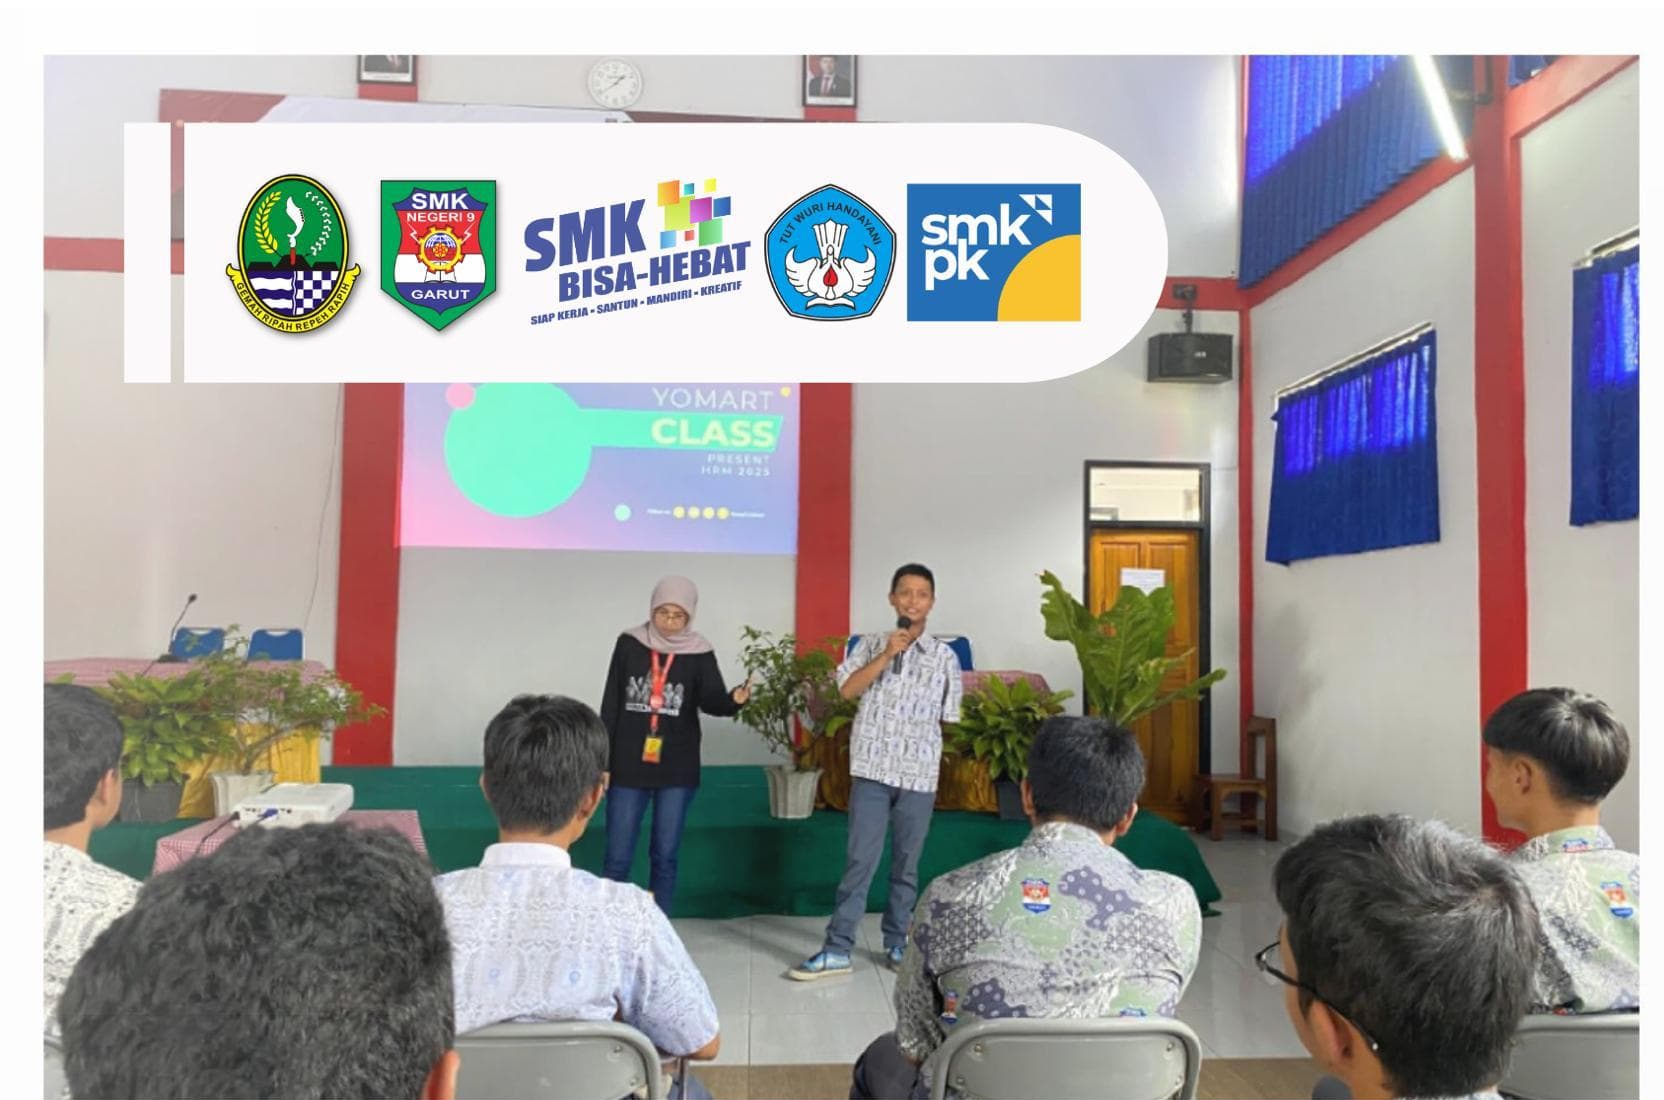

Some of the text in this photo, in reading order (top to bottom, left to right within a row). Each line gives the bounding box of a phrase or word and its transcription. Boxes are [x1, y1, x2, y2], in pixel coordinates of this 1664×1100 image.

[652, 387, 774, 411] YOMART
[651, 417, 775, 447] CLASS
[707, 453, 770, 464] PRESENT
[701, 465, 732, 475] HRM
